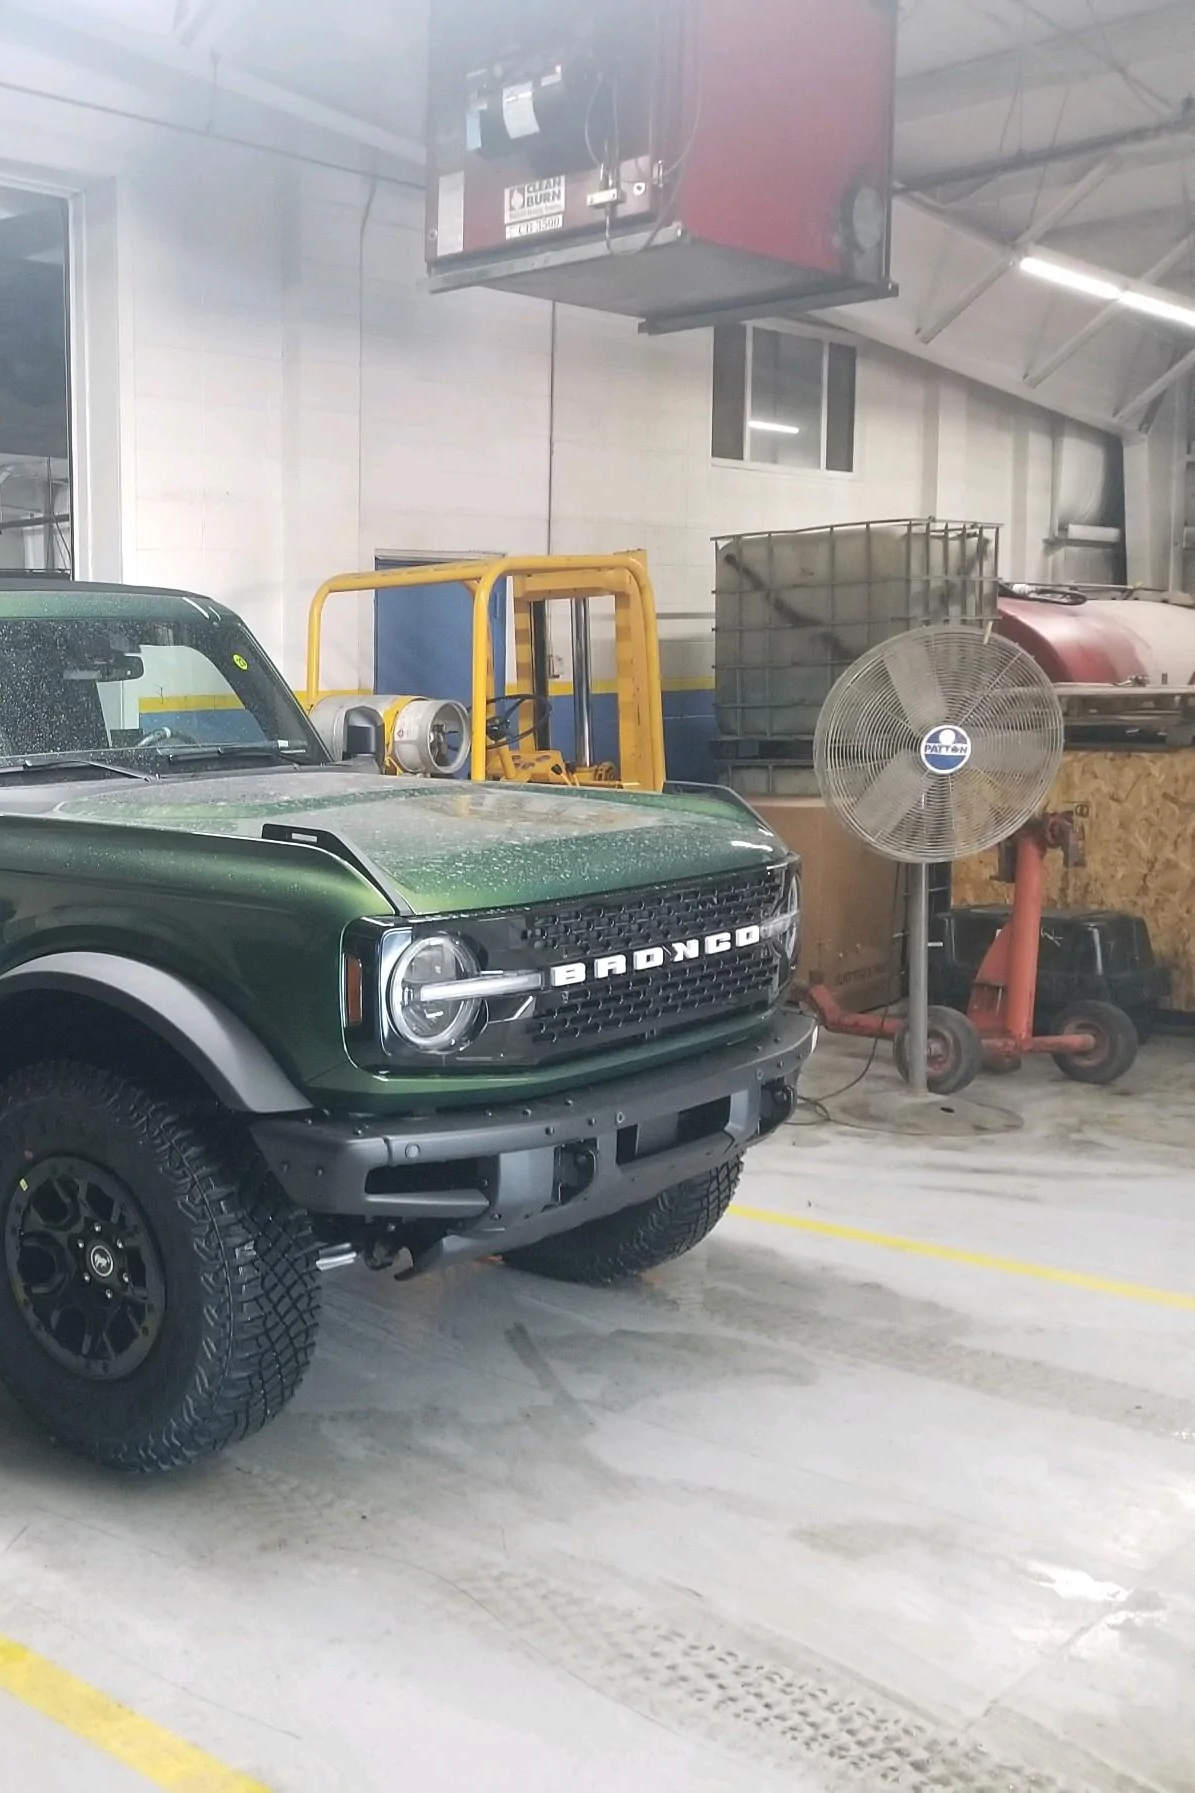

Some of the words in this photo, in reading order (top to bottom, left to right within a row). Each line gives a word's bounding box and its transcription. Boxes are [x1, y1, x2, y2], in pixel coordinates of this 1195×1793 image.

[526, 176, 562, 194] CLEAN
[526, 189, 562, 207] BURN
[924, 744, 968, 754] PATTON
[550, 925, 760, 987] BRONCO
